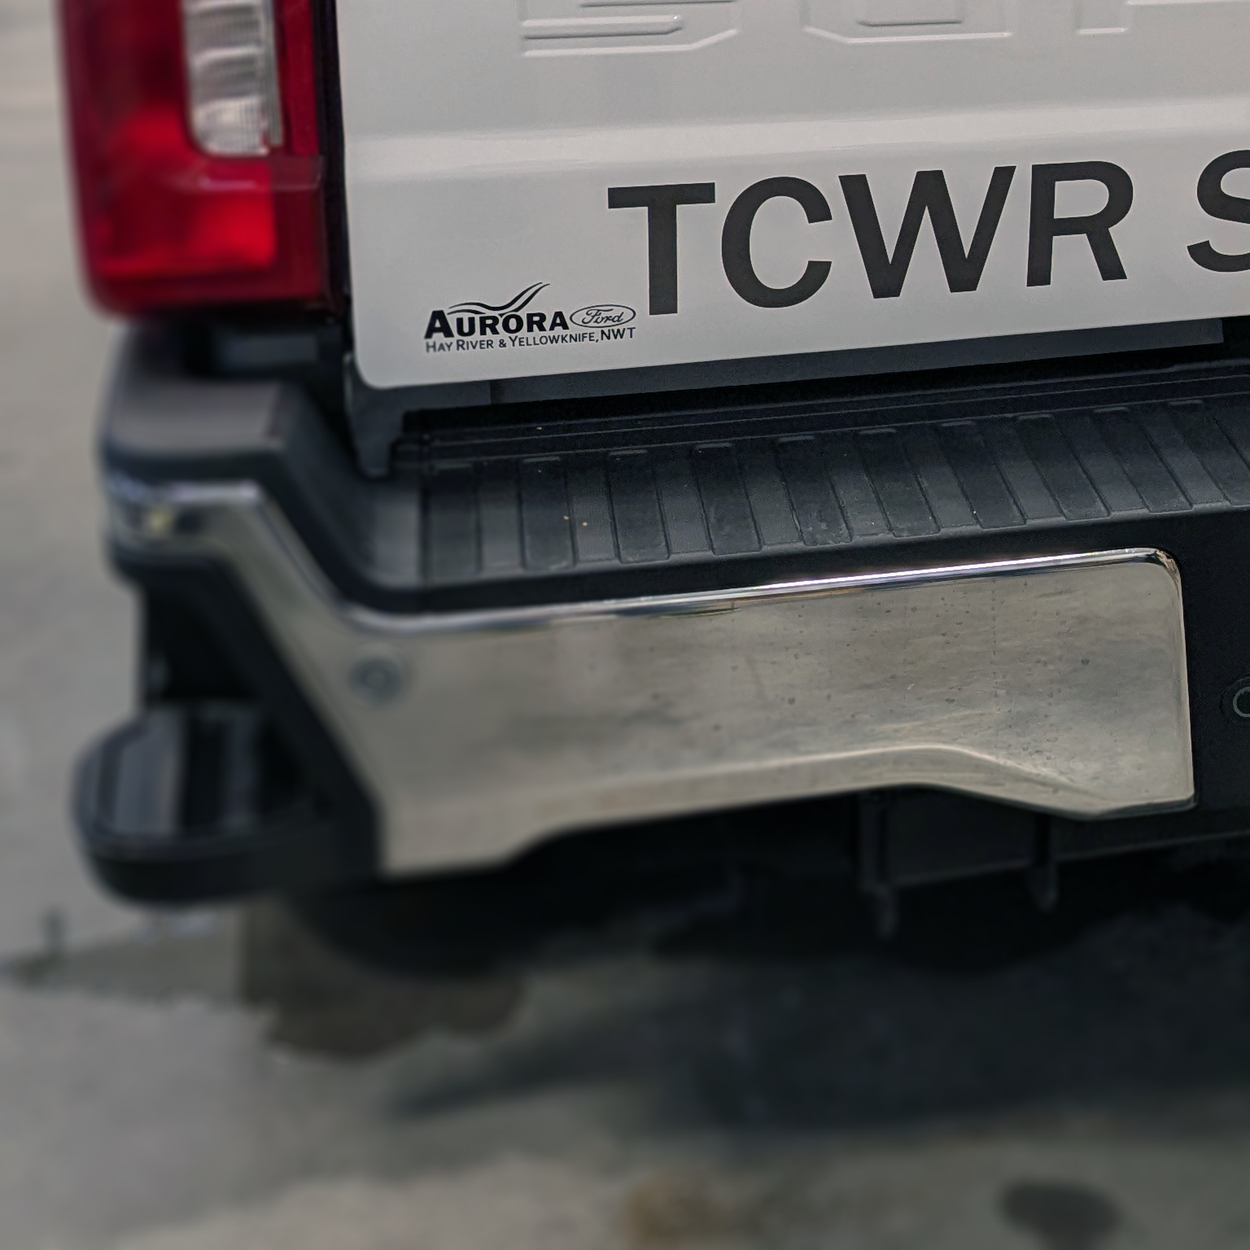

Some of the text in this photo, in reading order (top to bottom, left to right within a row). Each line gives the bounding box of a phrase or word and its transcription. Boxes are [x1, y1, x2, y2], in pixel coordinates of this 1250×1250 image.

[606, 159, 1135, 317] TCWR
[424, 309, 570, 340] AURORA
[425, 340, 454, 353] HAY
[456, 338, 495, 352] RIVER
[498, 338, 507, 349] &
